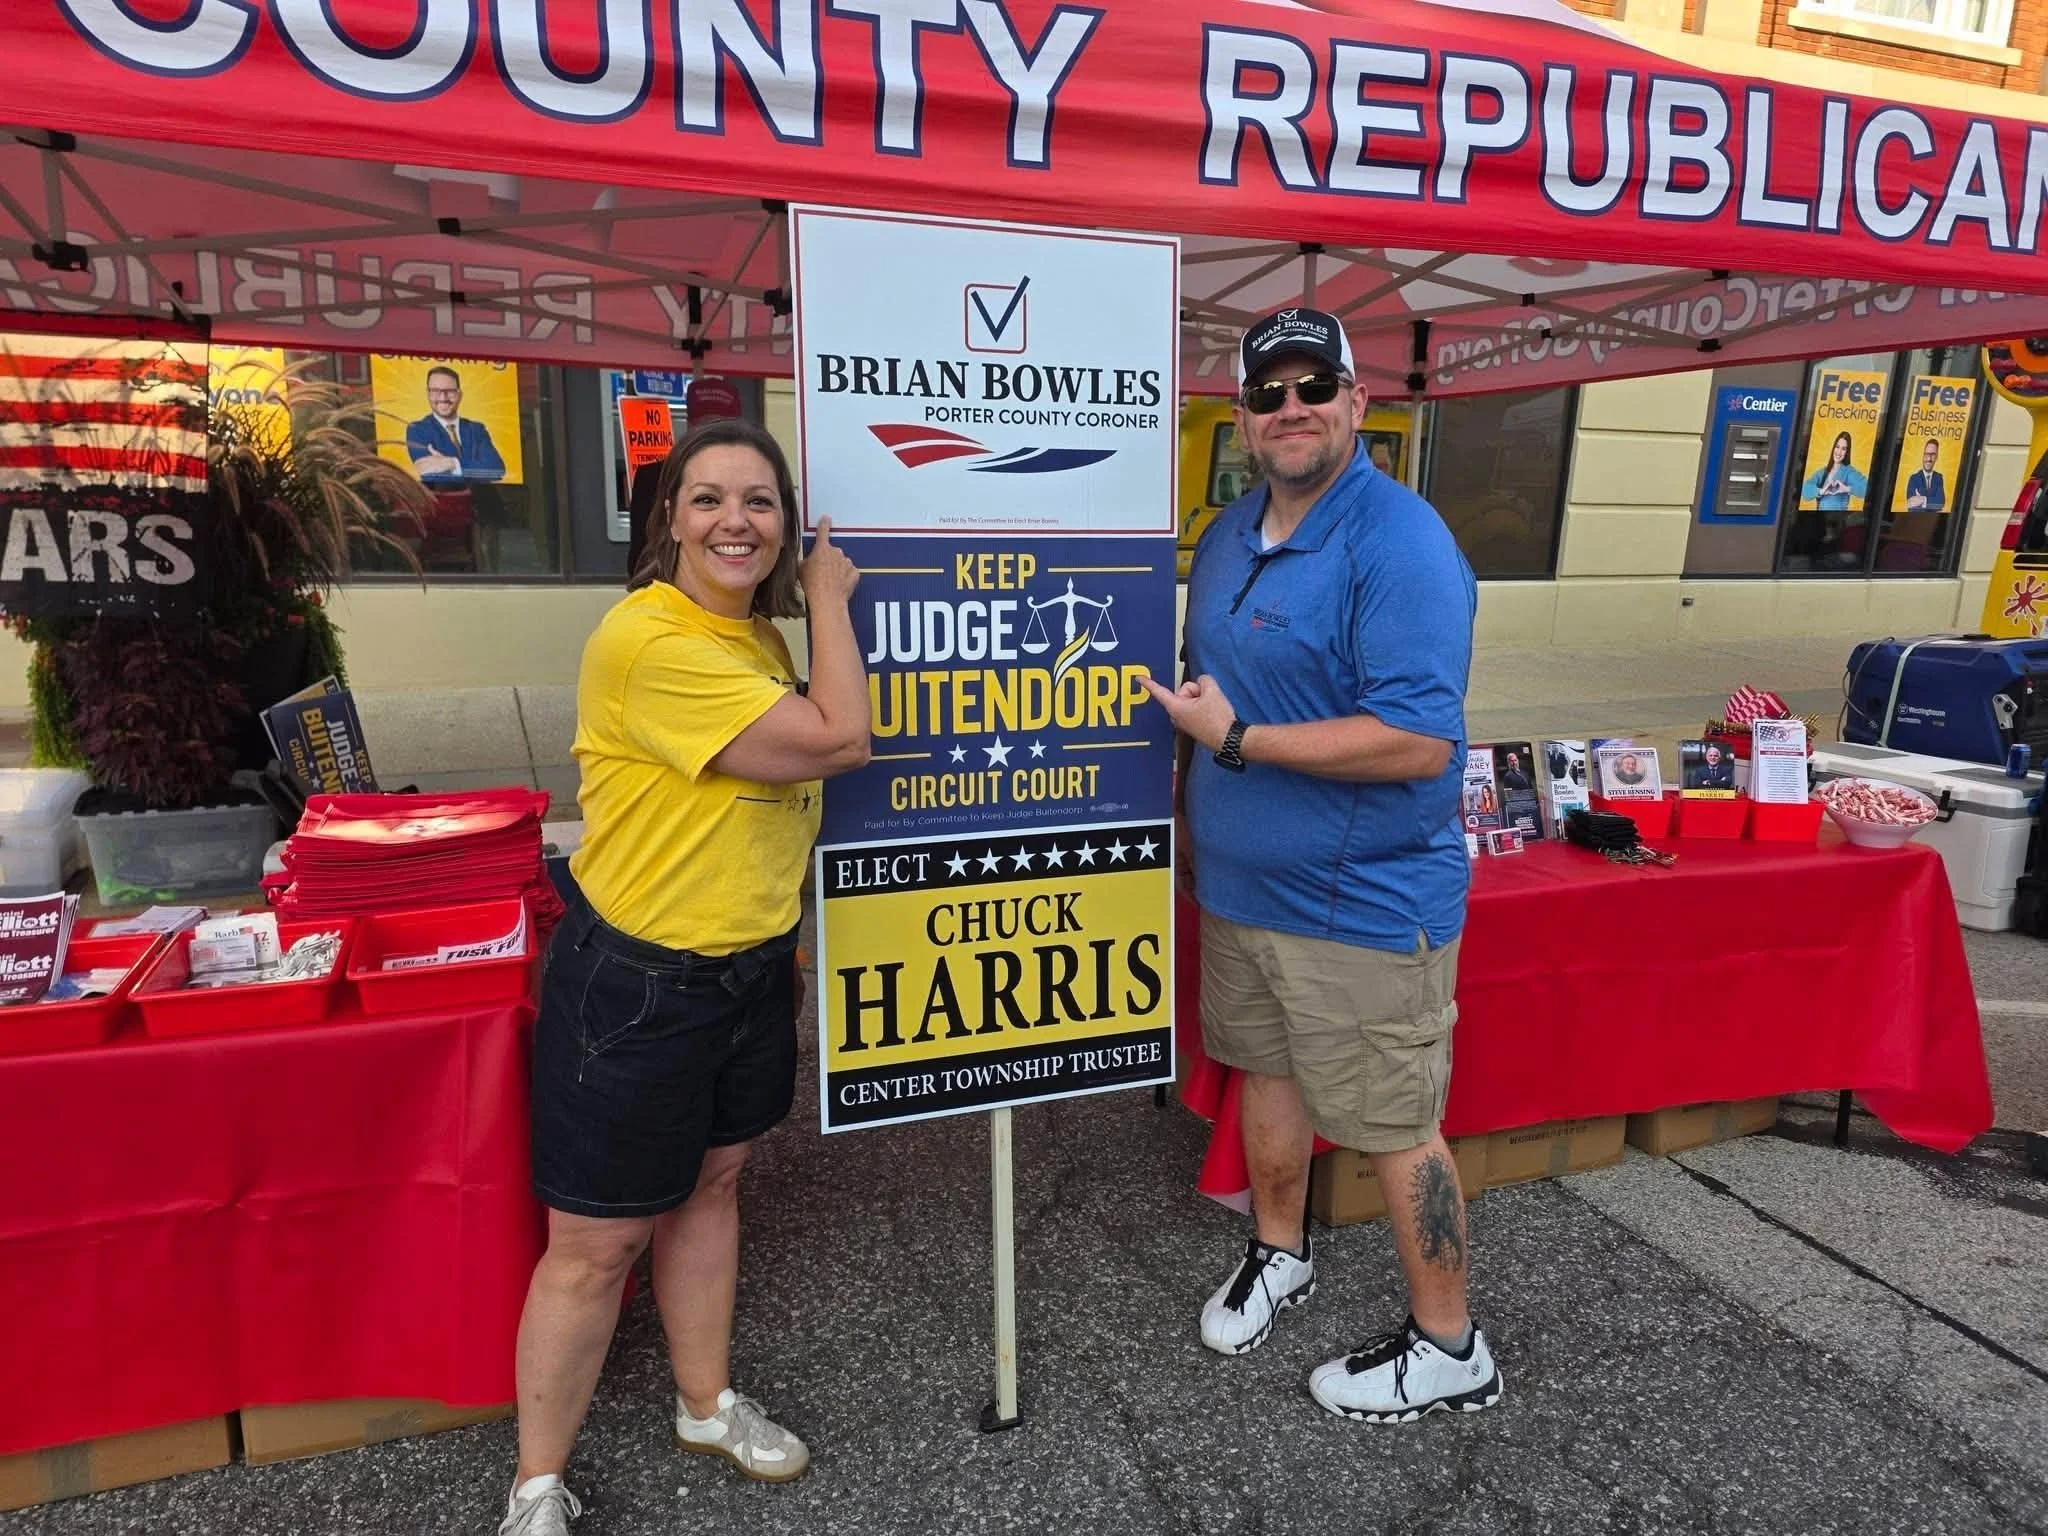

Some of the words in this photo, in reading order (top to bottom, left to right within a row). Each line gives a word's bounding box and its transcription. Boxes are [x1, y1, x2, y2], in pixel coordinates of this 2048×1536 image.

[1252, 323, 1281, 348] BRIAN
[1284, 321, 1328, 335] BOWLES
[816, 354, 969, 399] BRIAN
[981, 363, 1161, 407] BOWLES
[1821, 375, 1882, 402] Free
[1914, 379, 1970, 408] Free
[645, 410, 660, 426] NO
[925, 406, 994, 425] PORTER
[998, 409, 1071, 426] COUNTY
[1075, 412, 1159, 429] CORONER
[1743, 396, 1788, 413] Centier
[1818, 404, 1878, 424] Checking
[1911, 406, 1966, 423] Business
[1907, 422, 1963, 441] Checking
[955, 553, 1036, 590] KEEP
[867, 599, 1017, 664] JUDGE
[867, 664, 1151, 737] UITENDORP
[326, 720, 359, 783] JUDGE
[354, 750, 373, 784] KEEP
[891, 771, 1003, 811] CIRCUIT
[1012, 765, 1100, 801] COURT
[864, 819, 885, 830] Paid
[887, 818, 899, 828] for
[903, 818, 916, 829] By
[918, 815, 968, 826] Committee
[970, 813, 980, 822] to
[981, 811, 1004, 822] Keep
[1006, 809, 1034, 820] Judge
[1035, 806, 1084, 817] Buitendorp
[836, 853, 930, 889] ELECT
[0, 911, 59, 931] lliott
[12, 927, 55, 937] Treasurer
[926, 891, 1083, 947] CHUCK
[447, 947, 492, 960] TUSK
[837, 933, 1162, 1053] HARRIS
[840, 1067, 937, 1106] CENTER
[941, 1055, 1064, 1091] TOWNSHIP
[1068, 1042, 1162, 1073] TRUSTEE
